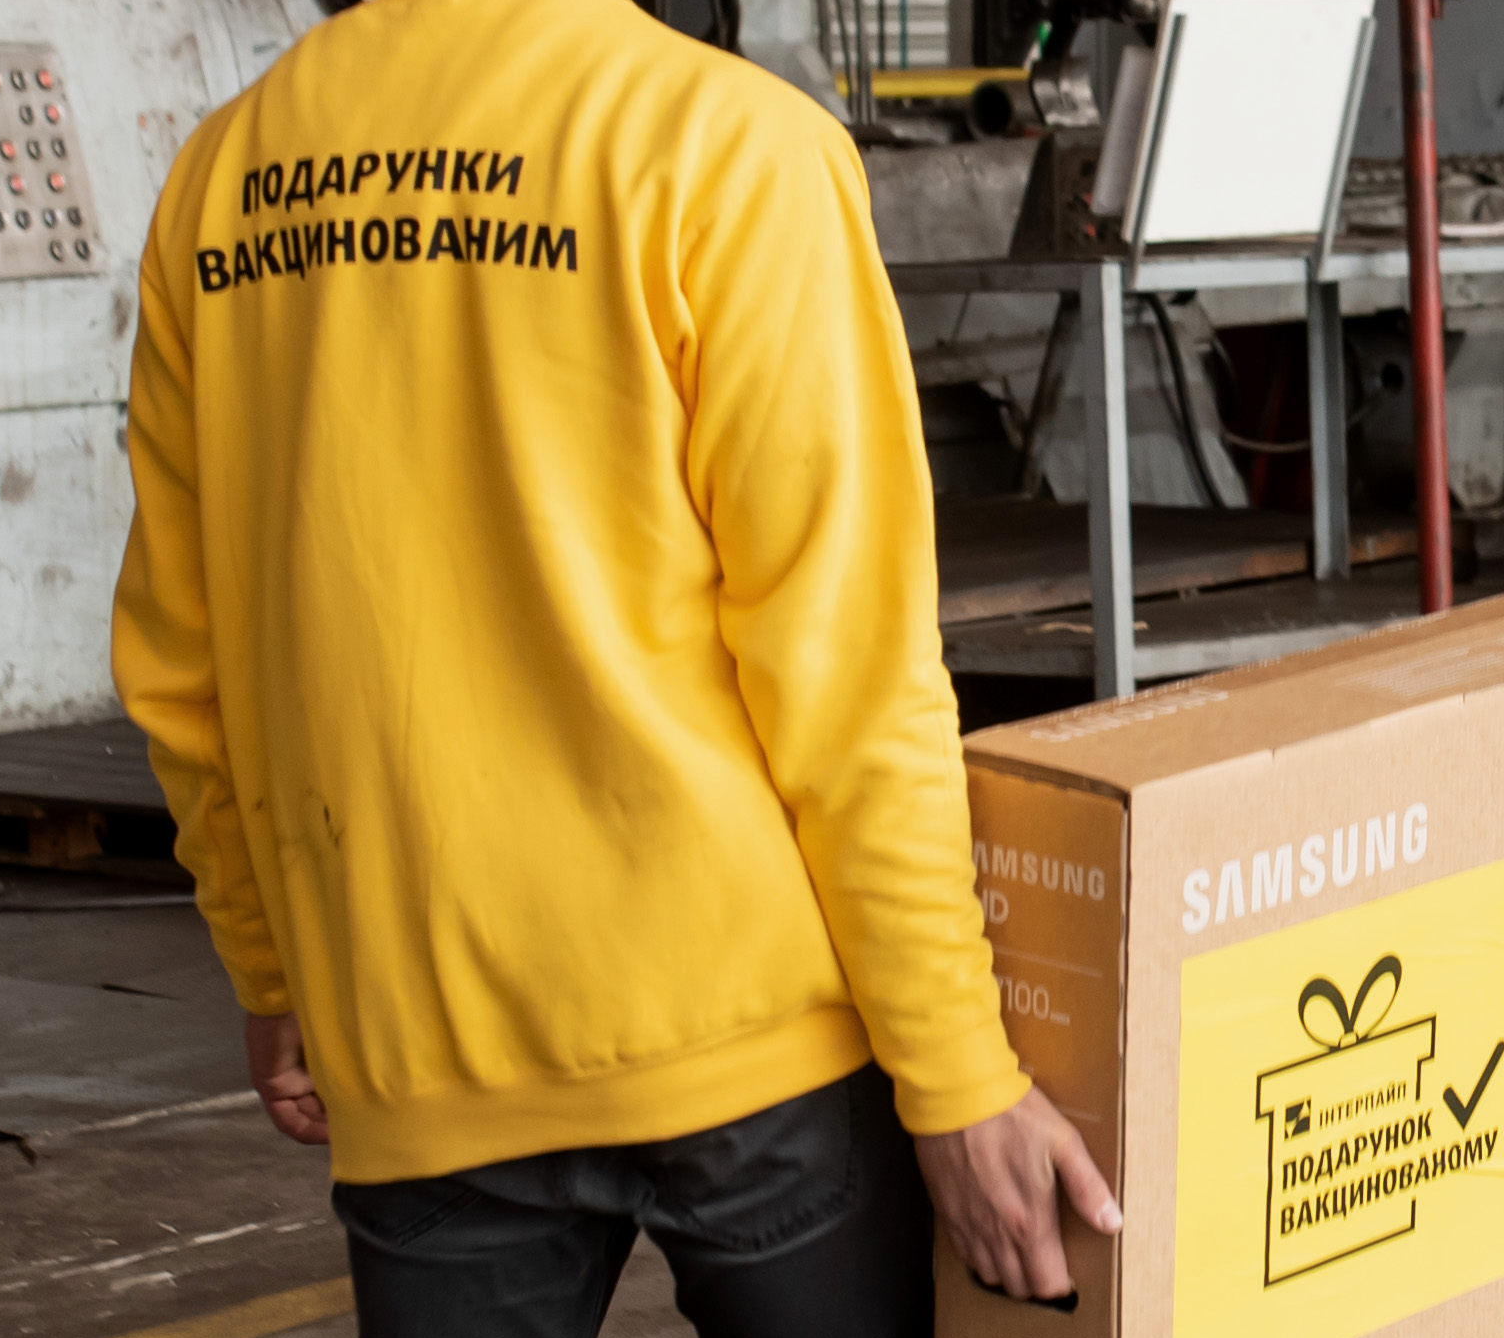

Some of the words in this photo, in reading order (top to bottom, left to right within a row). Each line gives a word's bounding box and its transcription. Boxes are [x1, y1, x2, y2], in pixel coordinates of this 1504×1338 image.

[241, 147, 525, 217] ПОДАРУНКИ
[195, 215, 579, 294] ВАКЦИНОВАНИМ
[972, 839, 1106, 902] AMSUNG
[1181, 802, 1429, 935] SAMSUNG
[1318, 1081, 1408, 1131] ІНТЕРПАЙП
[1279, 1128, 1500, 1237] ВАКЦИНОВАНОМУ
[1281, 1110, 1433, 1191] ПОДАРУНОК
